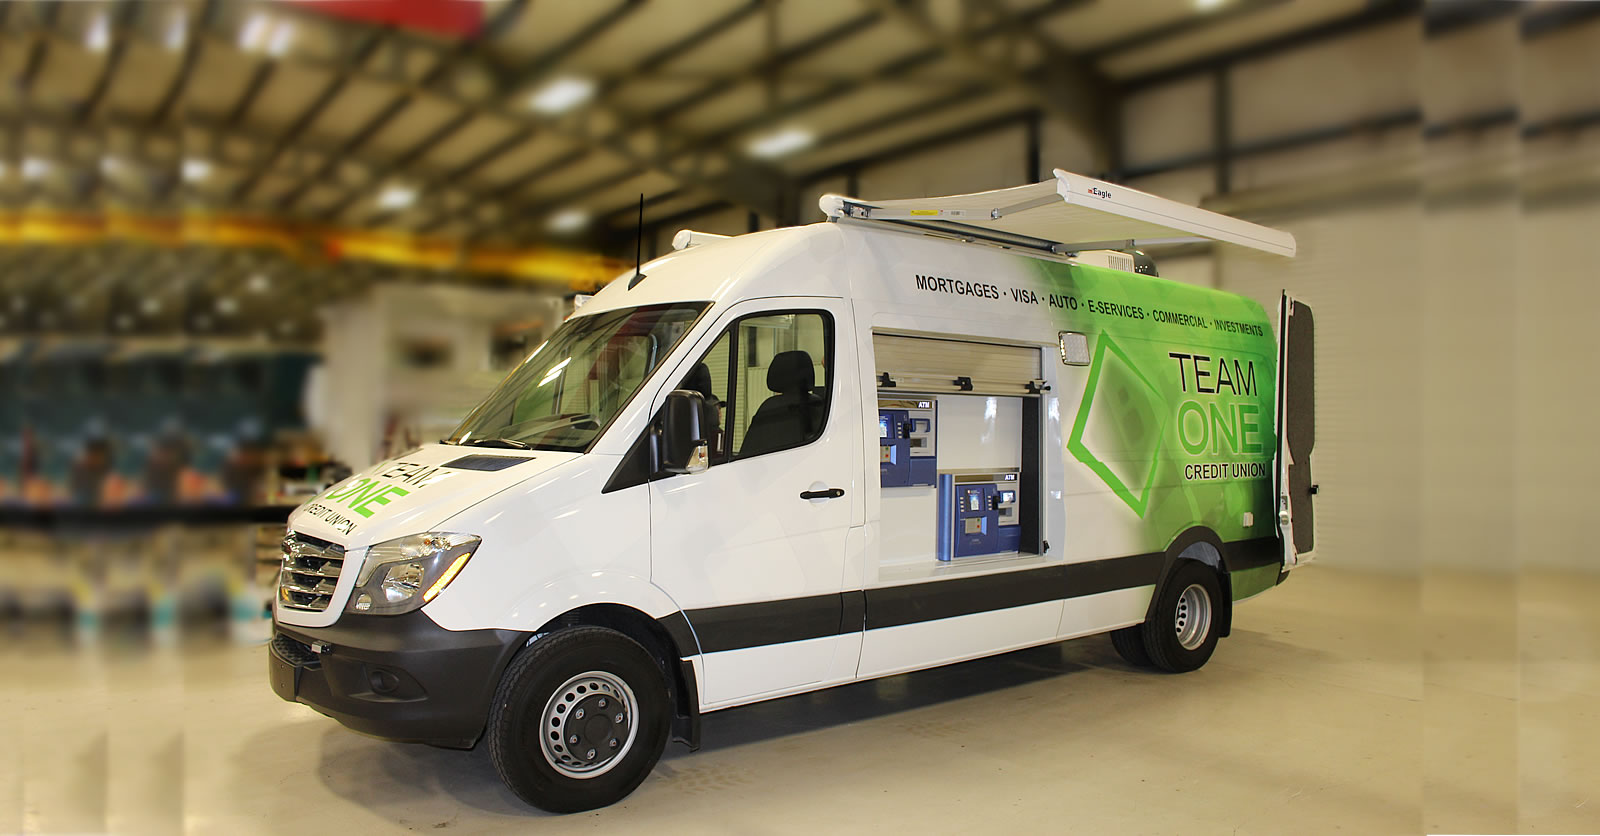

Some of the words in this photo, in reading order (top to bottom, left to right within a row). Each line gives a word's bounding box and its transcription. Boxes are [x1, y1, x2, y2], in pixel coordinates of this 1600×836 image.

[1093, 187, 1112, 199] Eagle
[915, 274, 999, 300] MORTGAGES
[1010, 287, 1039, 305] VISA
[1049, 293, 1078, 311] AUTO
[1087, 299, 1145, 320] E-SERVICES
[1152, 309, 1208, 329] COMMERCIAL
[1214, 319, 1264, 337] INVESTMENTS
[1169, 352, 1258, 397] TEAM
[918, 401, 930, 409] ATM
[1177, 400, 1264, 456] ONE
[1185, 463, 1229, 480] CREDIT
[1232, 463, 1266, 478] UNION
[325, 477, 410, 519] ONE
[325, 512, 358, 536] UNION
